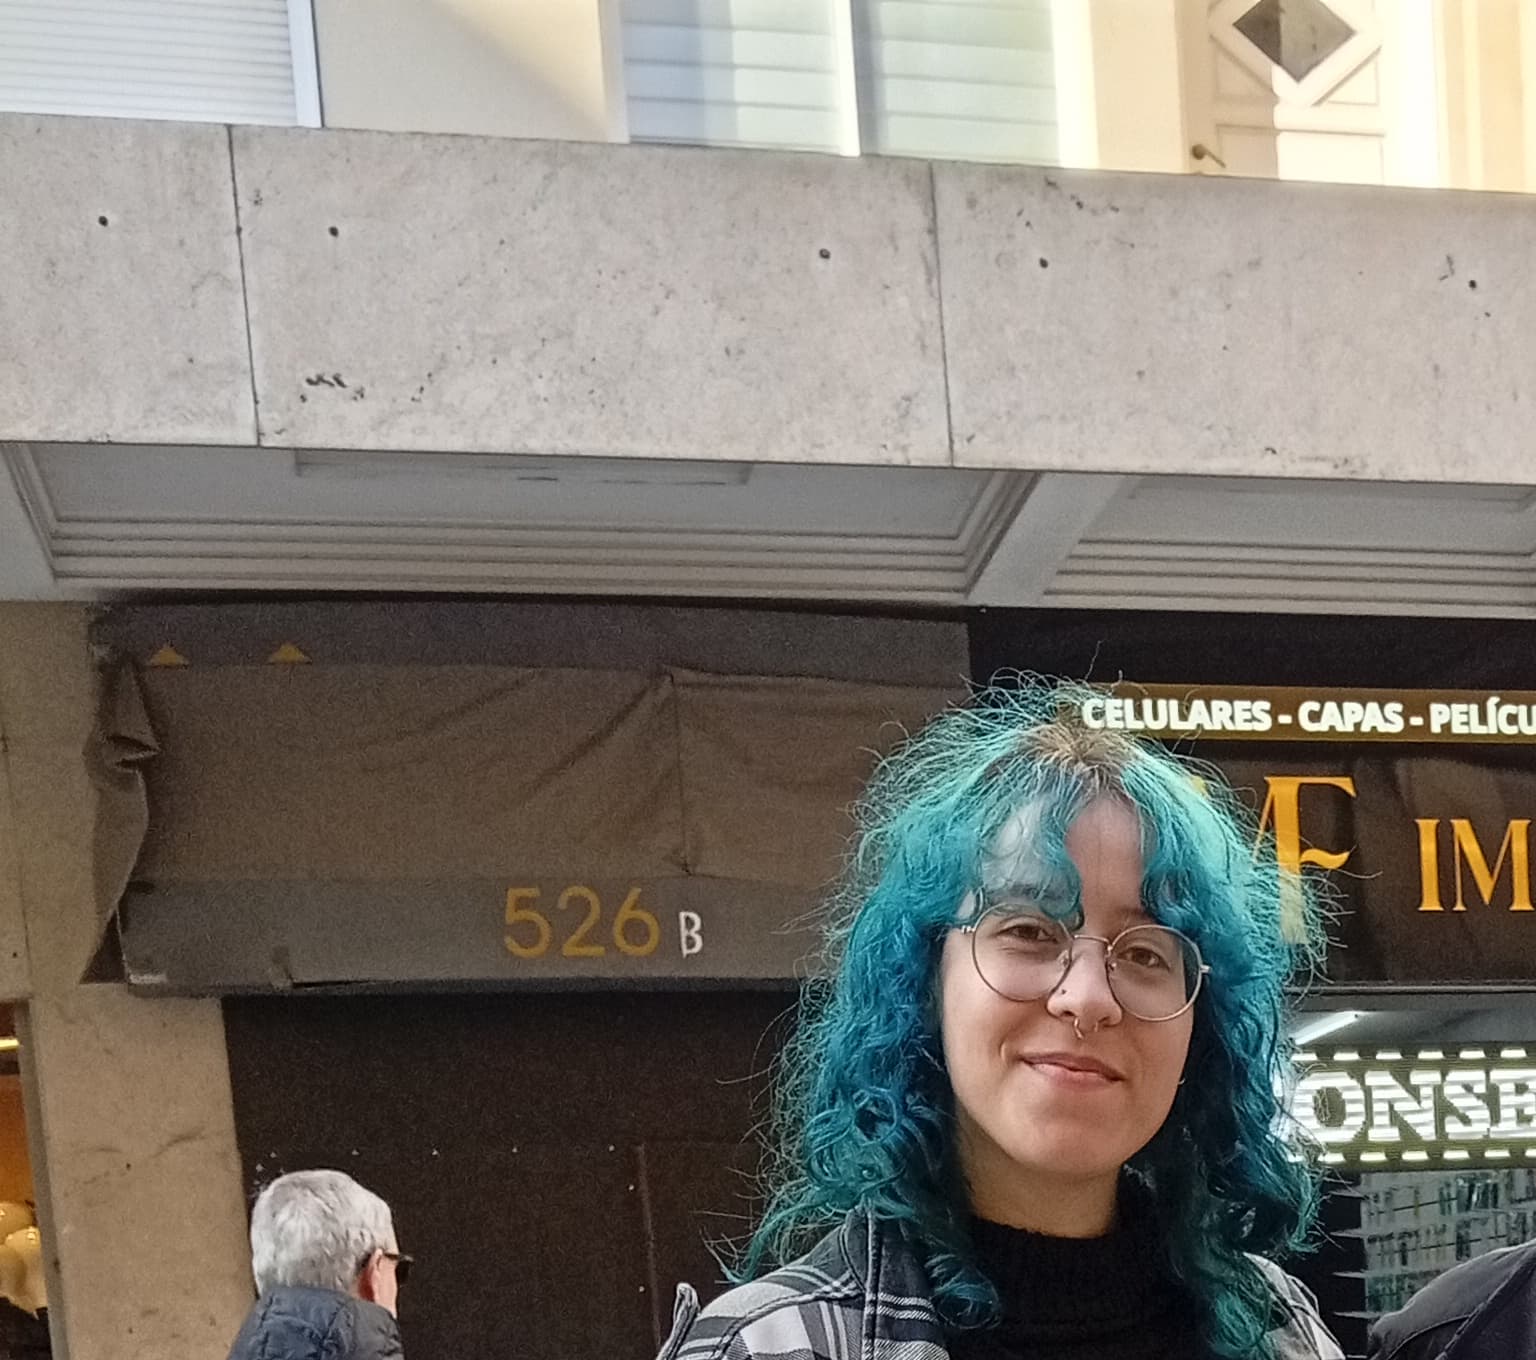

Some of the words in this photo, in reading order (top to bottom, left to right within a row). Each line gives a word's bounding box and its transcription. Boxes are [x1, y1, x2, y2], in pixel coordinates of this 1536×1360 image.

[1081, 697, 1272, 731] CELULARES
[1298, 700, 1404, 733] CAPAS
[503, 884, 661, 959] 526
[679, 910, 704, 958] B
